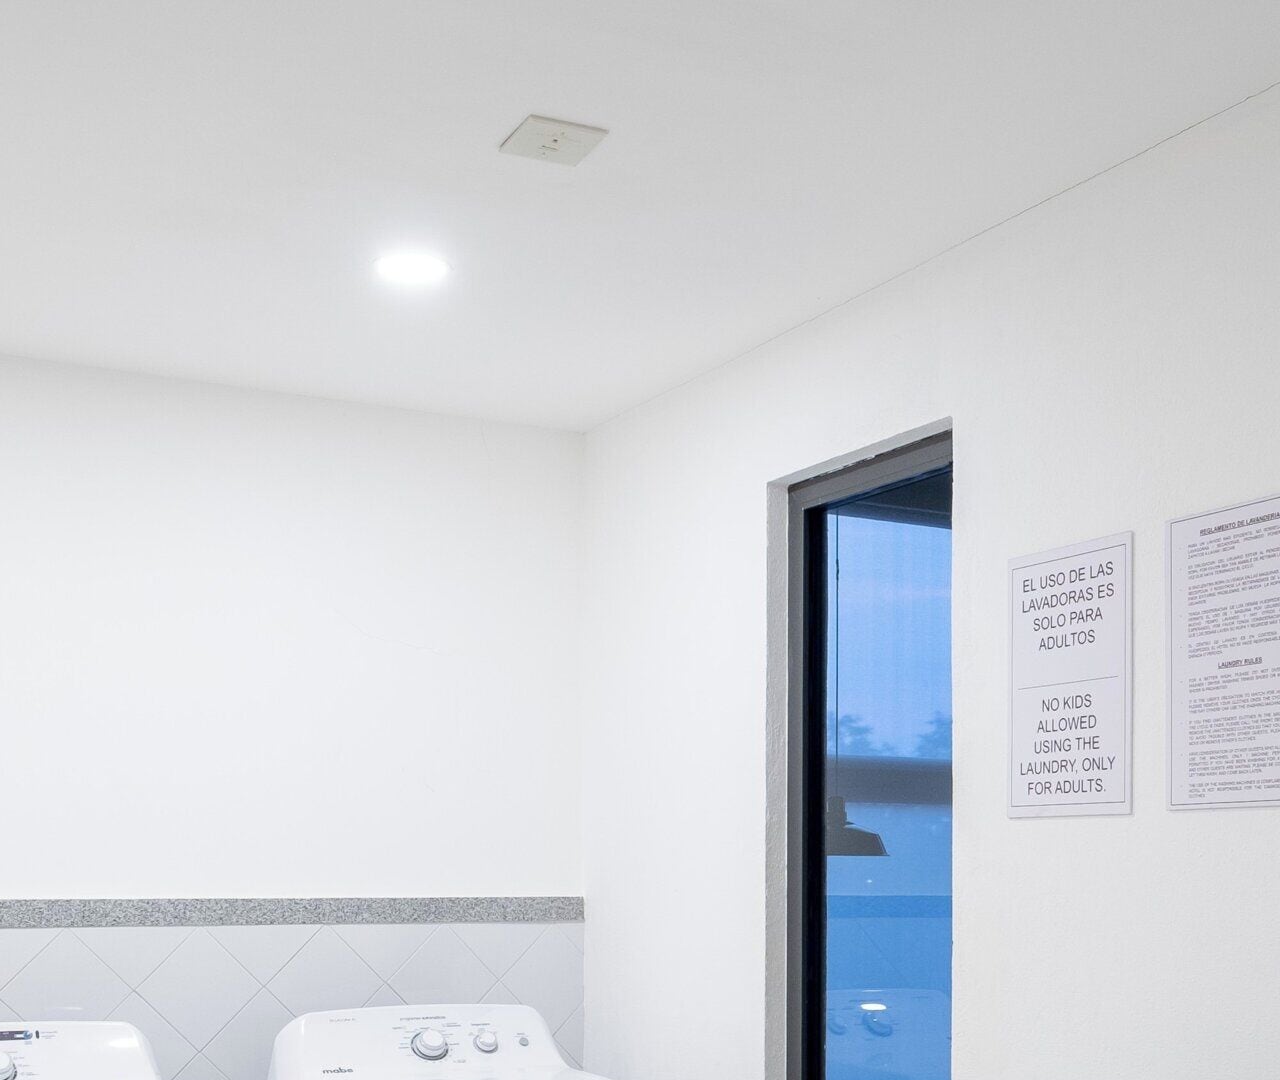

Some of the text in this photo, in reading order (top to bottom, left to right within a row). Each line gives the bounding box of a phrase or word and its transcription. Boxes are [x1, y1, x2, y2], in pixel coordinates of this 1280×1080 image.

[1022, 560, 1113, 593] EL USO DE LAS
[1022, 582, 1114, 613] LAVADORAS ES
[1033, 606, 1102, 631] SOLO PARA
[1038, 628, 1095, 651] ADULTOS
[1218, 656, 1262, 669] LAUNDRY RULES
[1042, 693, 1091, 712] NO KIDS
[1037, 714, 1096, 733] ALLOWED
[1034, 735, 1099, 754] USING THE
[1020, 755, 1115, 777] LAUNDRY, ONLY
[1027, 778, 1105, 795] FOR ADULTS.
